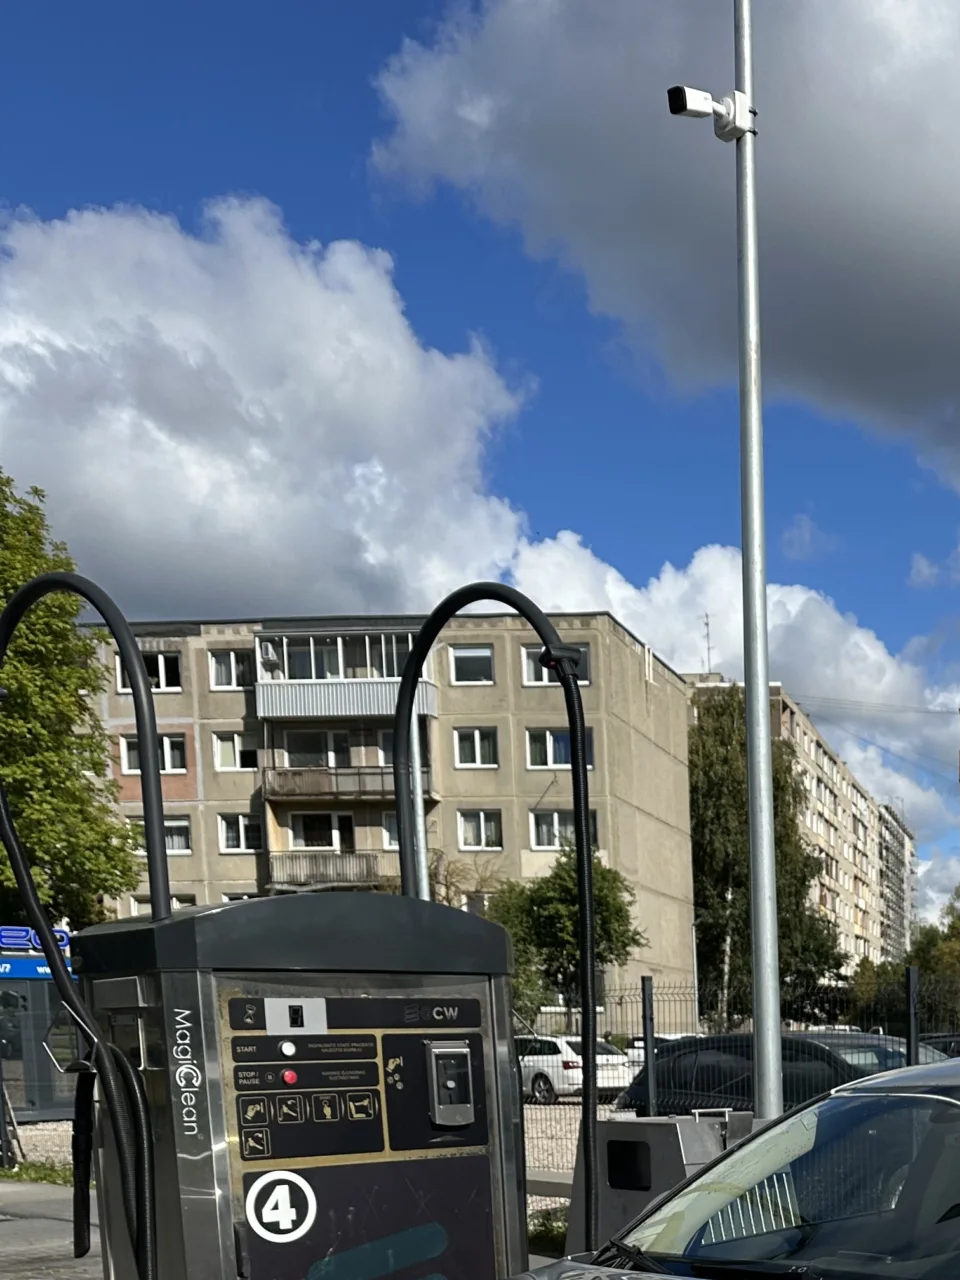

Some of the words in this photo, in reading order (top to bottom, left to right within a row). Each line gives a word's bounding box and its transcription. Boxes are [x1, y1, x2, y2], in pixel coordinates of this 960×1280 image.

[173, 1008, 202, 1135] MagiClean
[236, 1046, 257, 1054] START
[262, 1184, 297, 1230] 4
